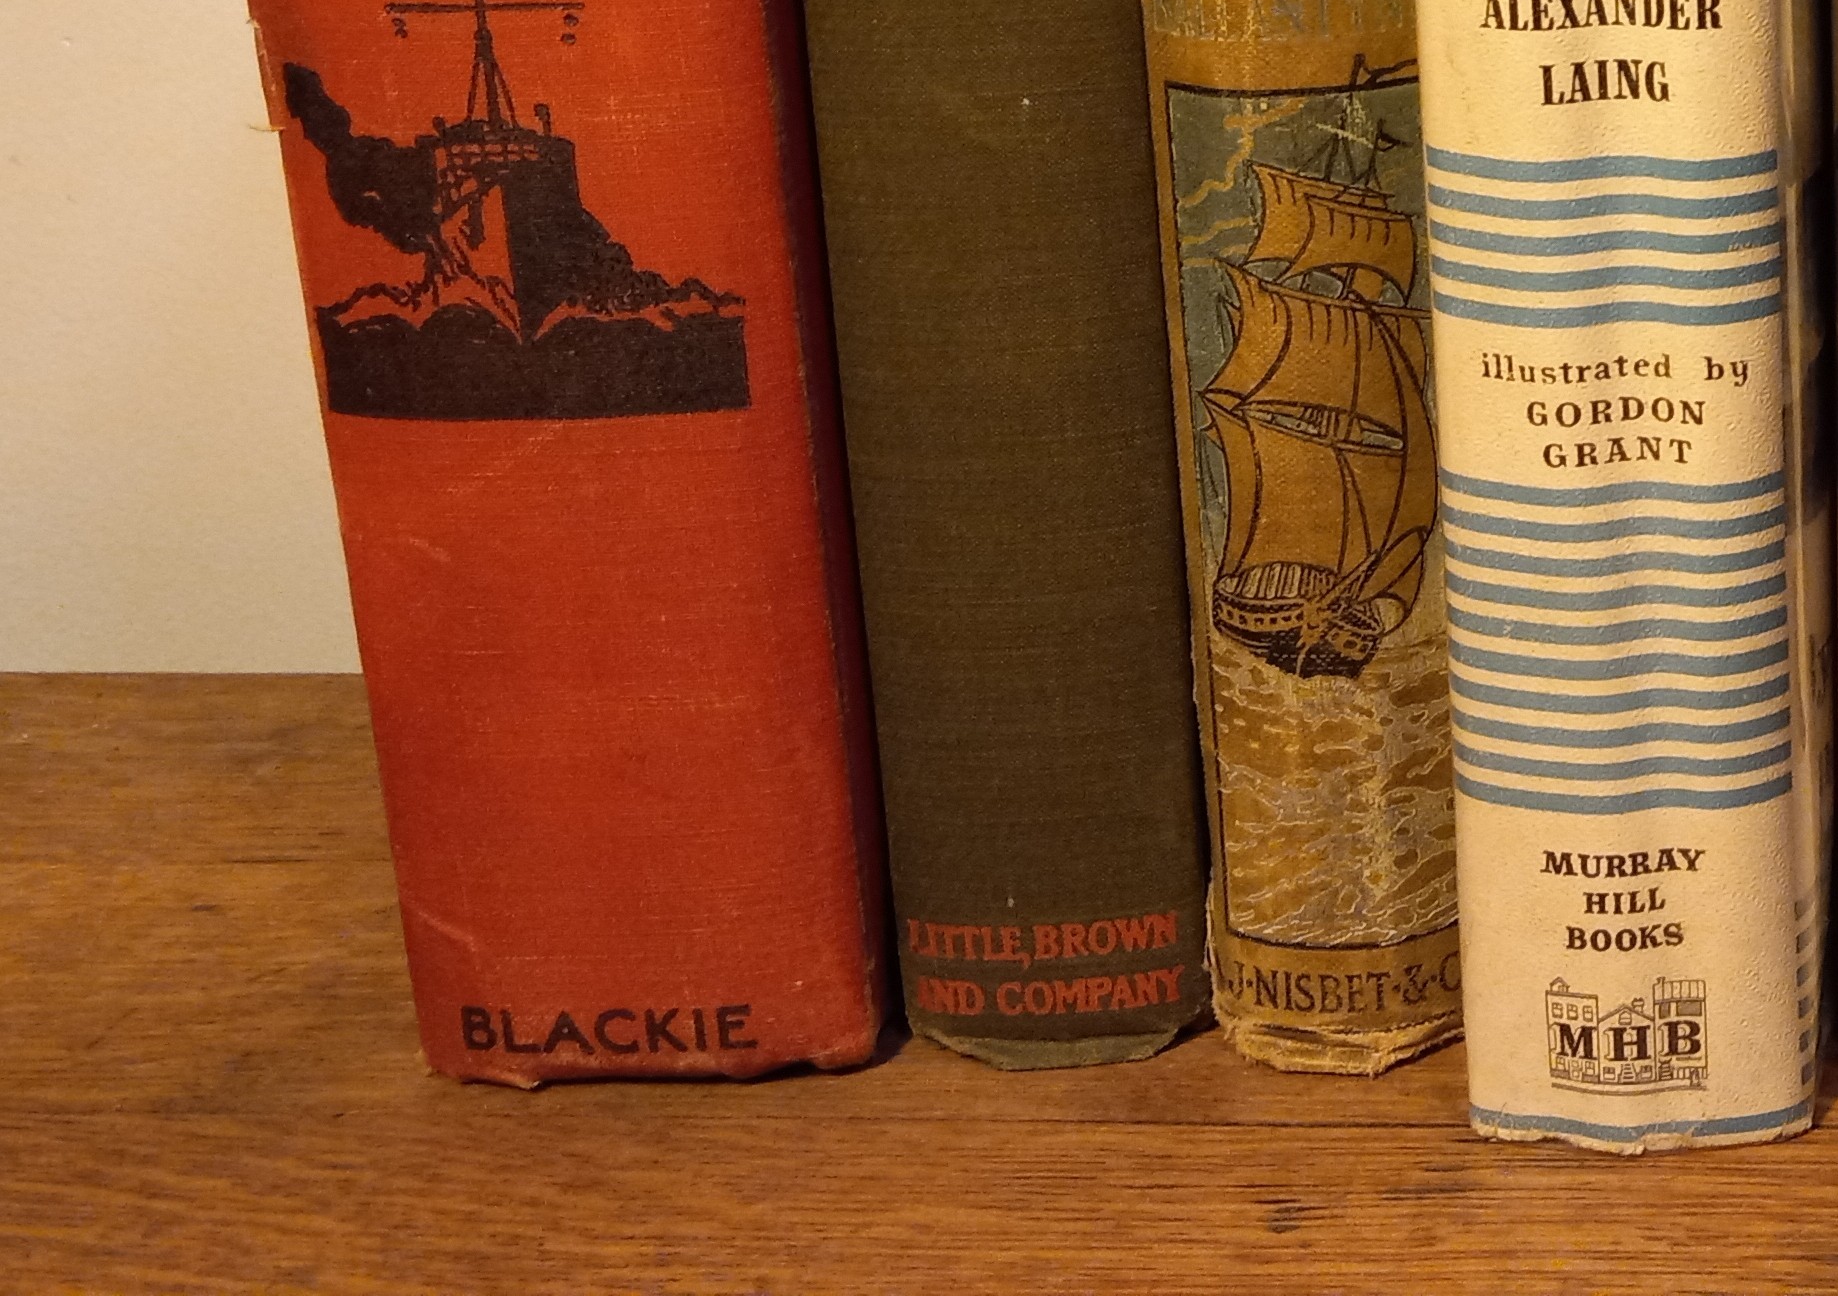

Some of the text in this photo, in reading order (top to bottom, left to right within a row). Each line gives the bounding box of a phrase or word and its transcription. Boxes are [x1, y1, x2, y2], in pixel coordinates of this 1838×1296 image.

[1539, 58, 1670, 106] LAING
[1480, 353, 1749, 386] illustrated by
[1526, 396, 1705, 428] GORDON
[1542, 436, 1693, 468] GRANT
[1540, 847, 1705, 879] MURRAY
[1583, 887, 1666, 915] HILL
[1565, 922, 1685, 952] BOOKS
[917, 964, 1184, 1016] AND COMPANY
[461, 1004, 758, 1055] BLACKIE
